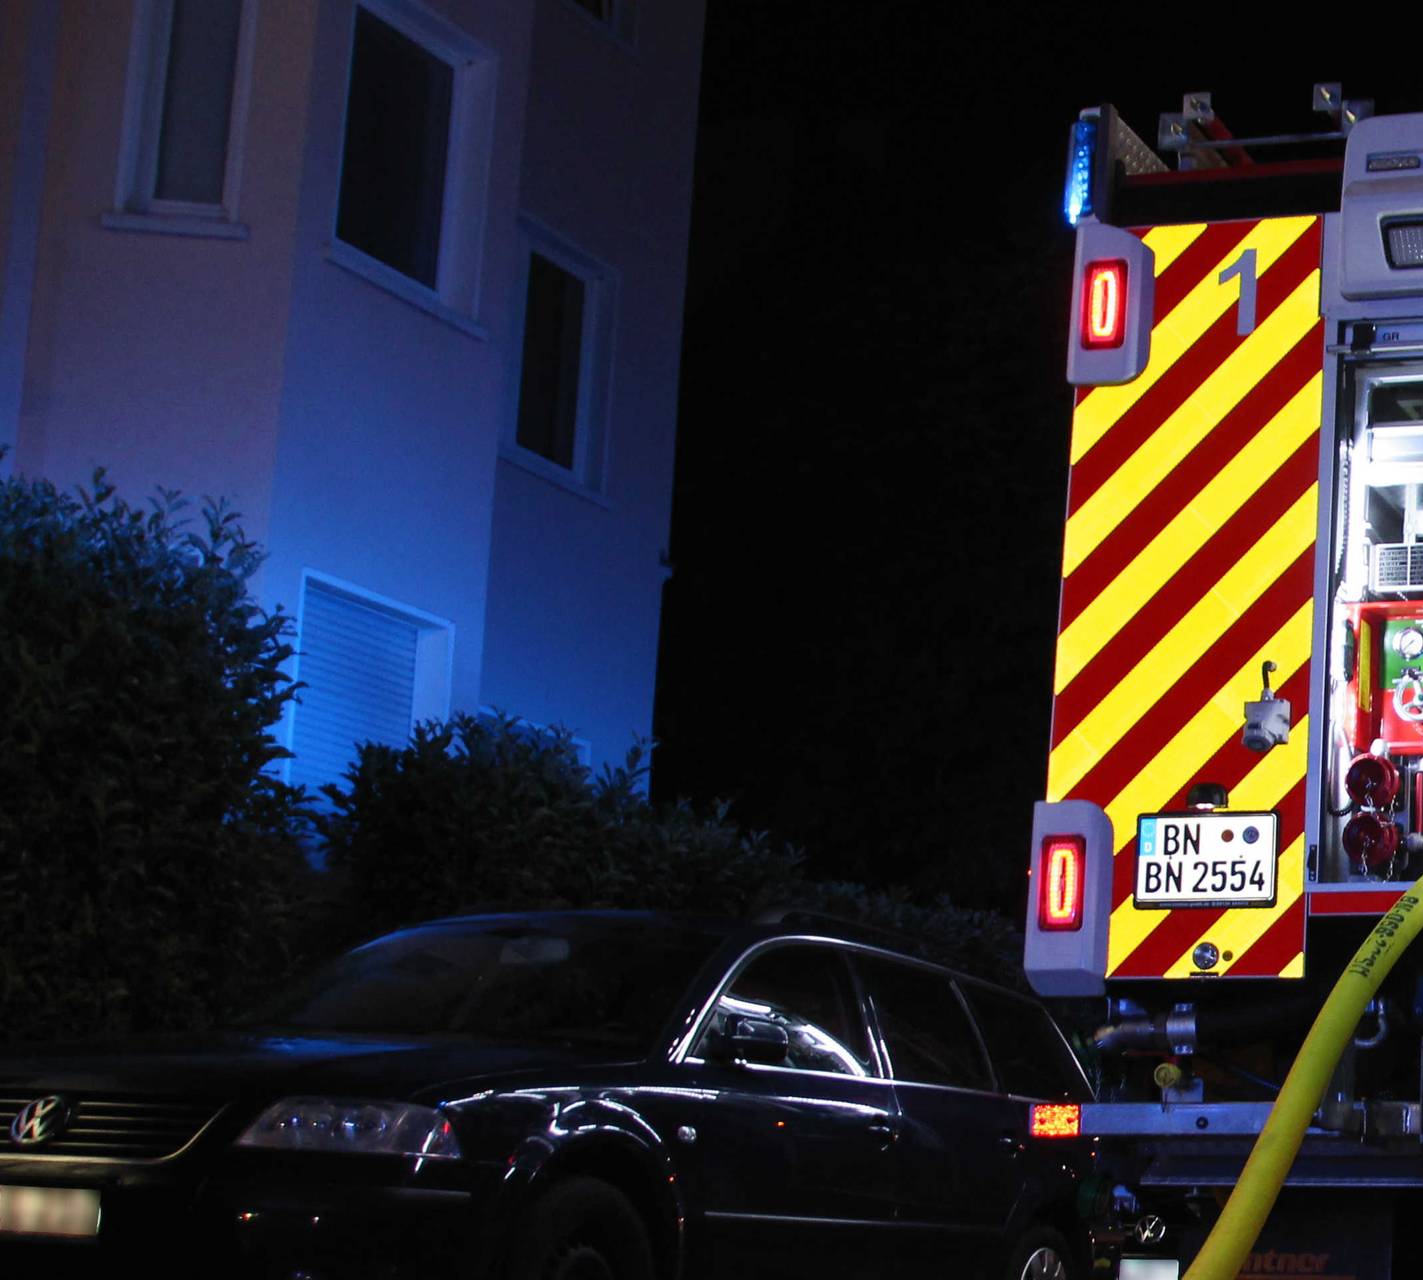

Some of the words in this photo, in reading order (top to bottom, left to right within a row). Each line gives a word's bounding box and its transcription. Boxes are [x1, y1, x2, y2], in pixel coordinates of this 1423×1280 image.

[1218, 248, 1257, 336] 1
[1163, 823, 1200, 855] BN
[1144, 861, 1182, 893] BN
[1192, 860, 1265, 893] 2554
[1242, 1248, 1331, 1274] ntner
